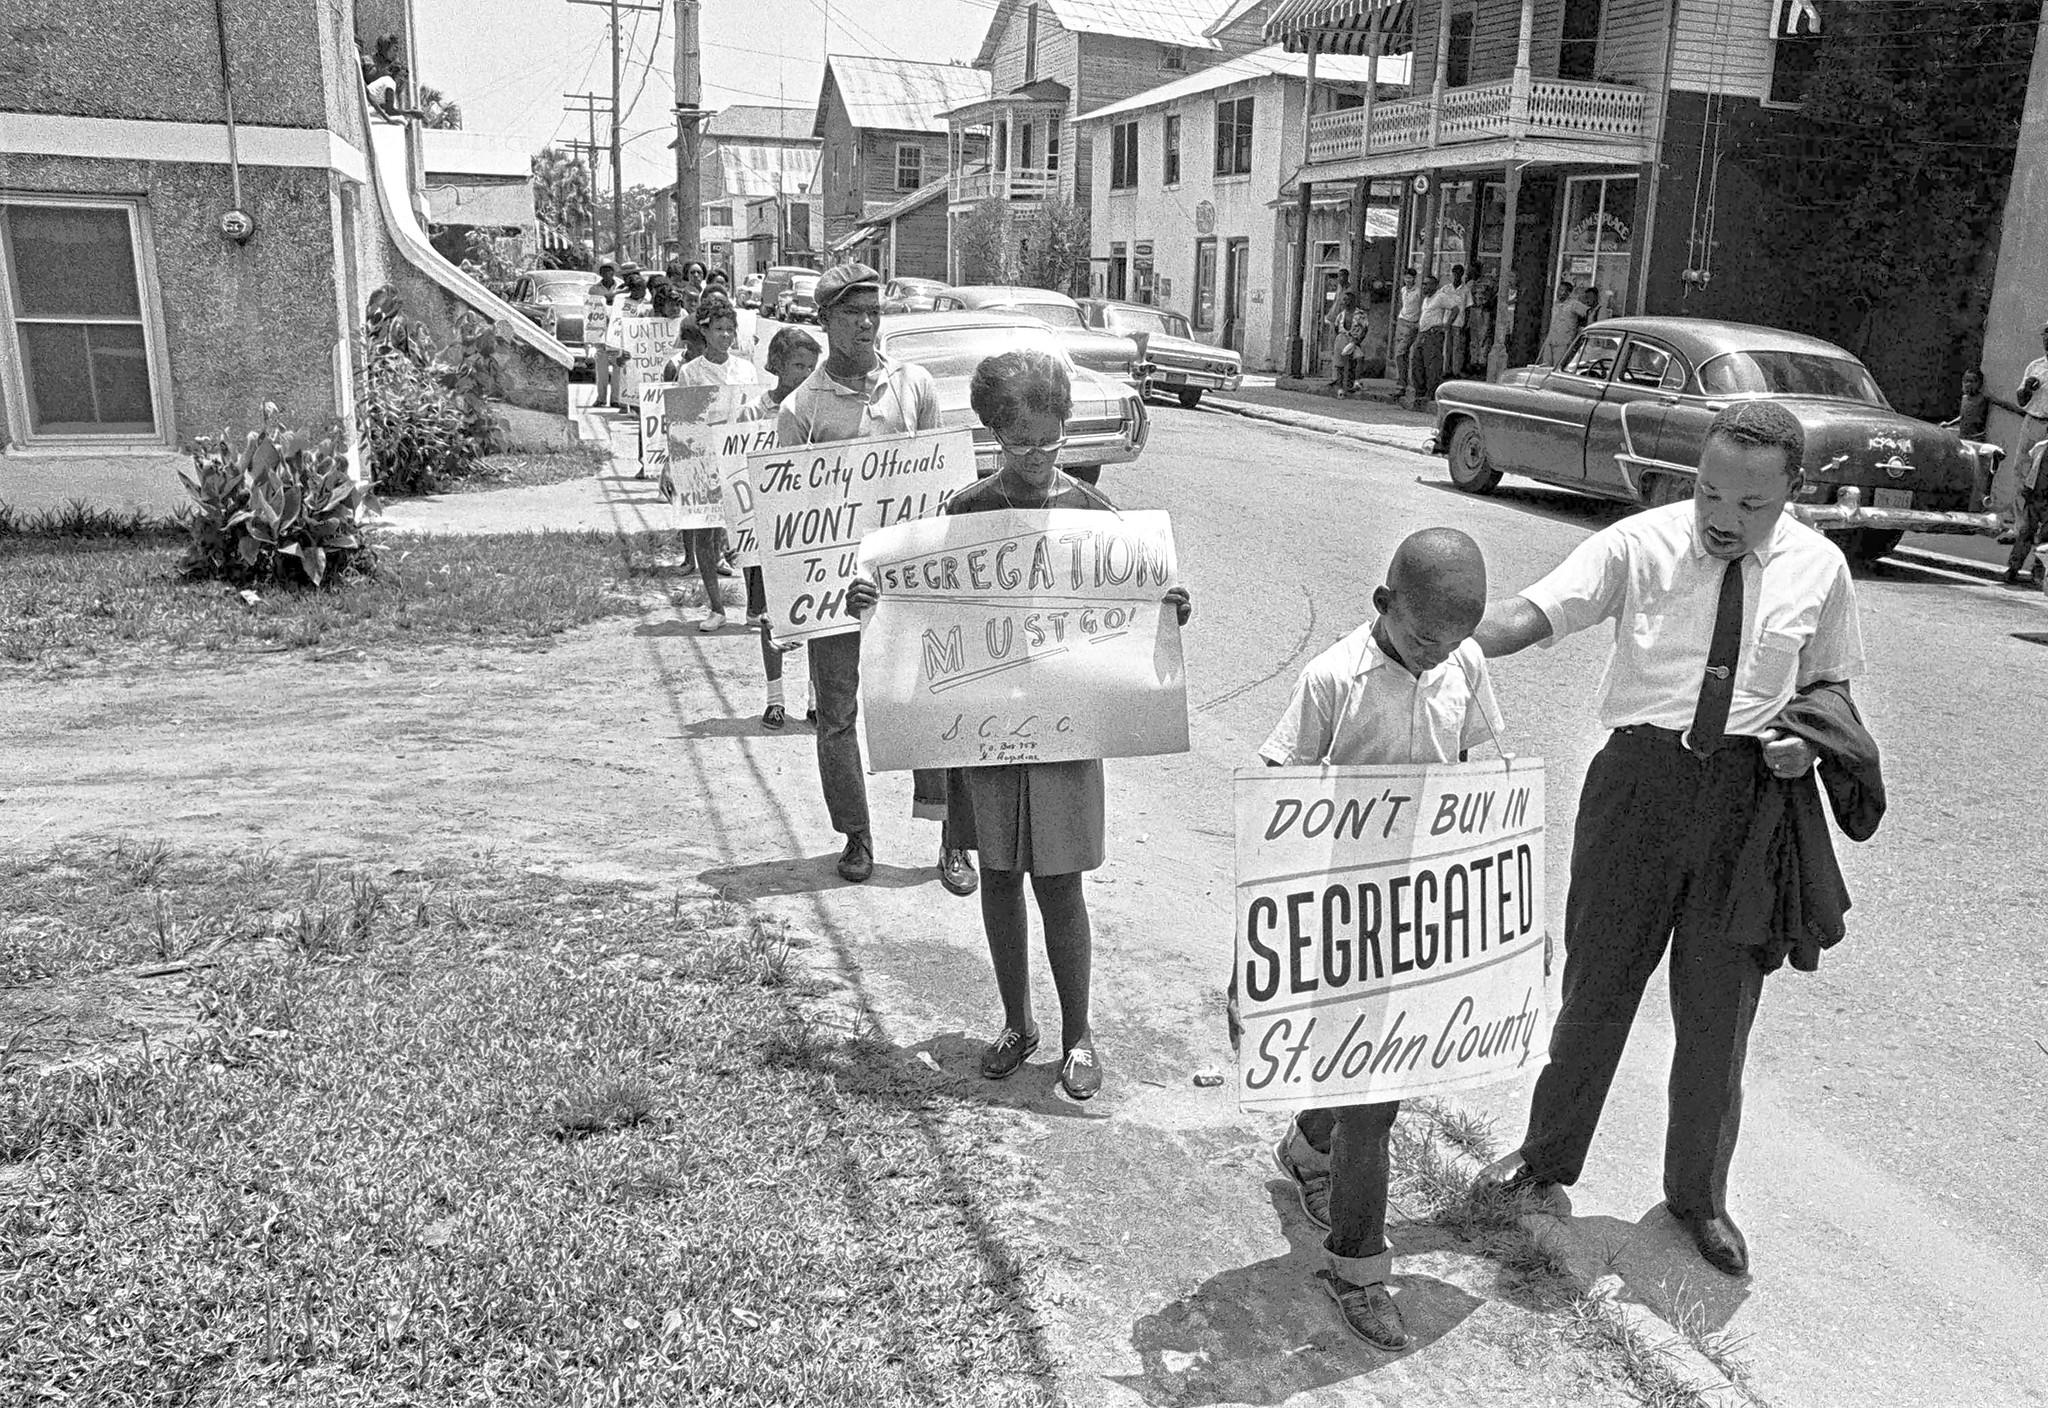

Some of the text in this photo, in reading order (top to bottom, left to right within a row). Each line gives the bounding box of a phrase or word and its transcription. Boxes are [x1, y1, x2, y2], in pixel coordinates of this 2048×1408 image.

[629, 322, 674, 339] UNTIL
[637, 342, 647, 354] IS
[643, 388, 664, 404] MY
[722, 430, 780, 456] MY FA
[759, 443, 945, 498] The City Officials
[737, 527, 759, 553] Th
[774, 502, 863, 551] WON'T
[804, 557, 826, 582] To
[884, 529, 1169, 591] SEGREGATION
[789, 588, 849, 625] CH
[921, 607, 1136, 680] MUST GO!
[1264, 788, 1530, 841] DON'T BUY IN
[1246, 843, 1533, 1002] SEGREGATED
[1245, 987, 1539, 1089] St. John County
